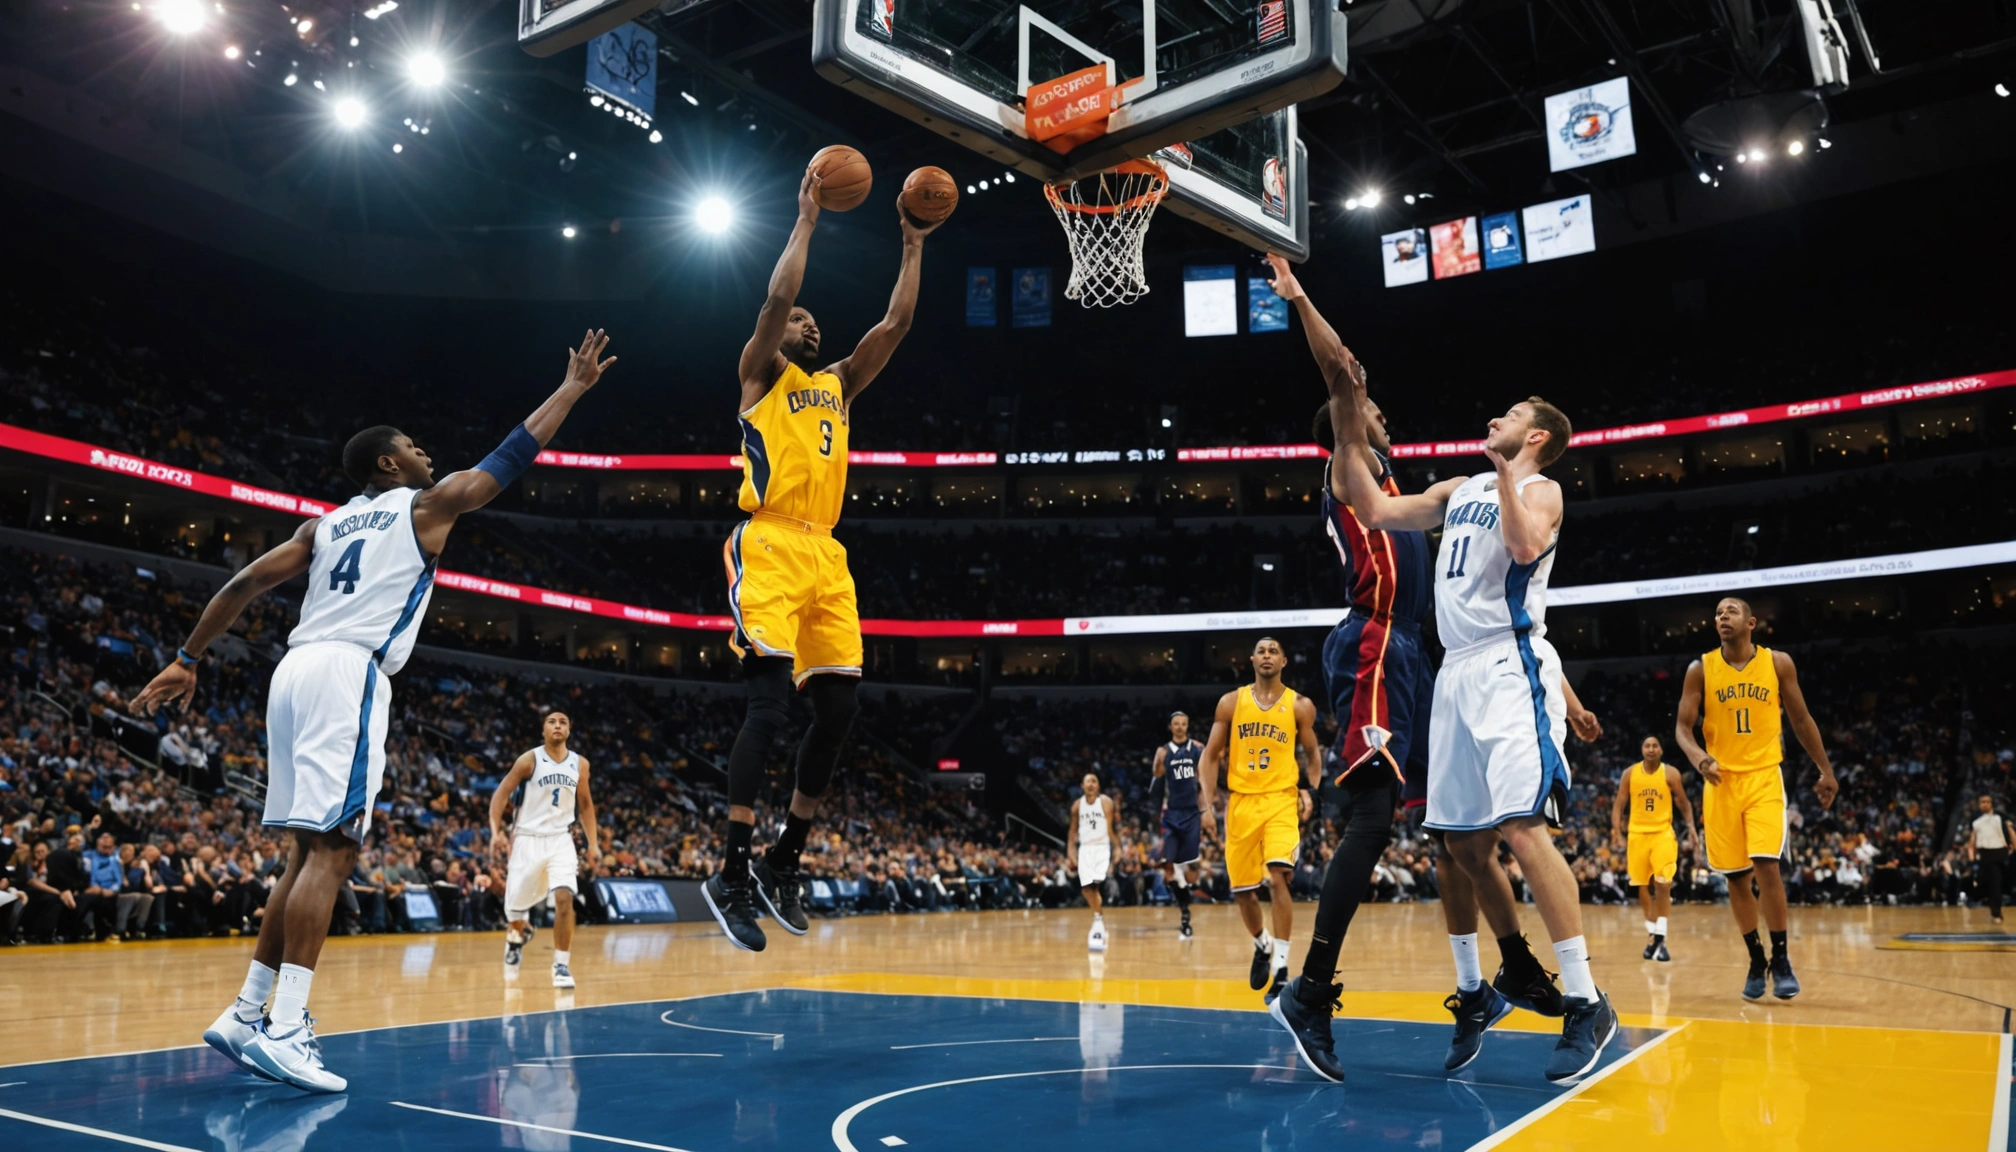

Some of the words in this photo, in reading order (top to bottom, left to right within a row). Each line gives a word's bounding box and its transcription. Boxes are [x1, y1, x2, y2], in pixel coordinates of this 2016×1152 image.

[819, 419, 833, 457] 3
[329, 538, 367, 595] 4
[1446, 535, 1472, 580] 11
[1735, 707, 1752, 734] 11
